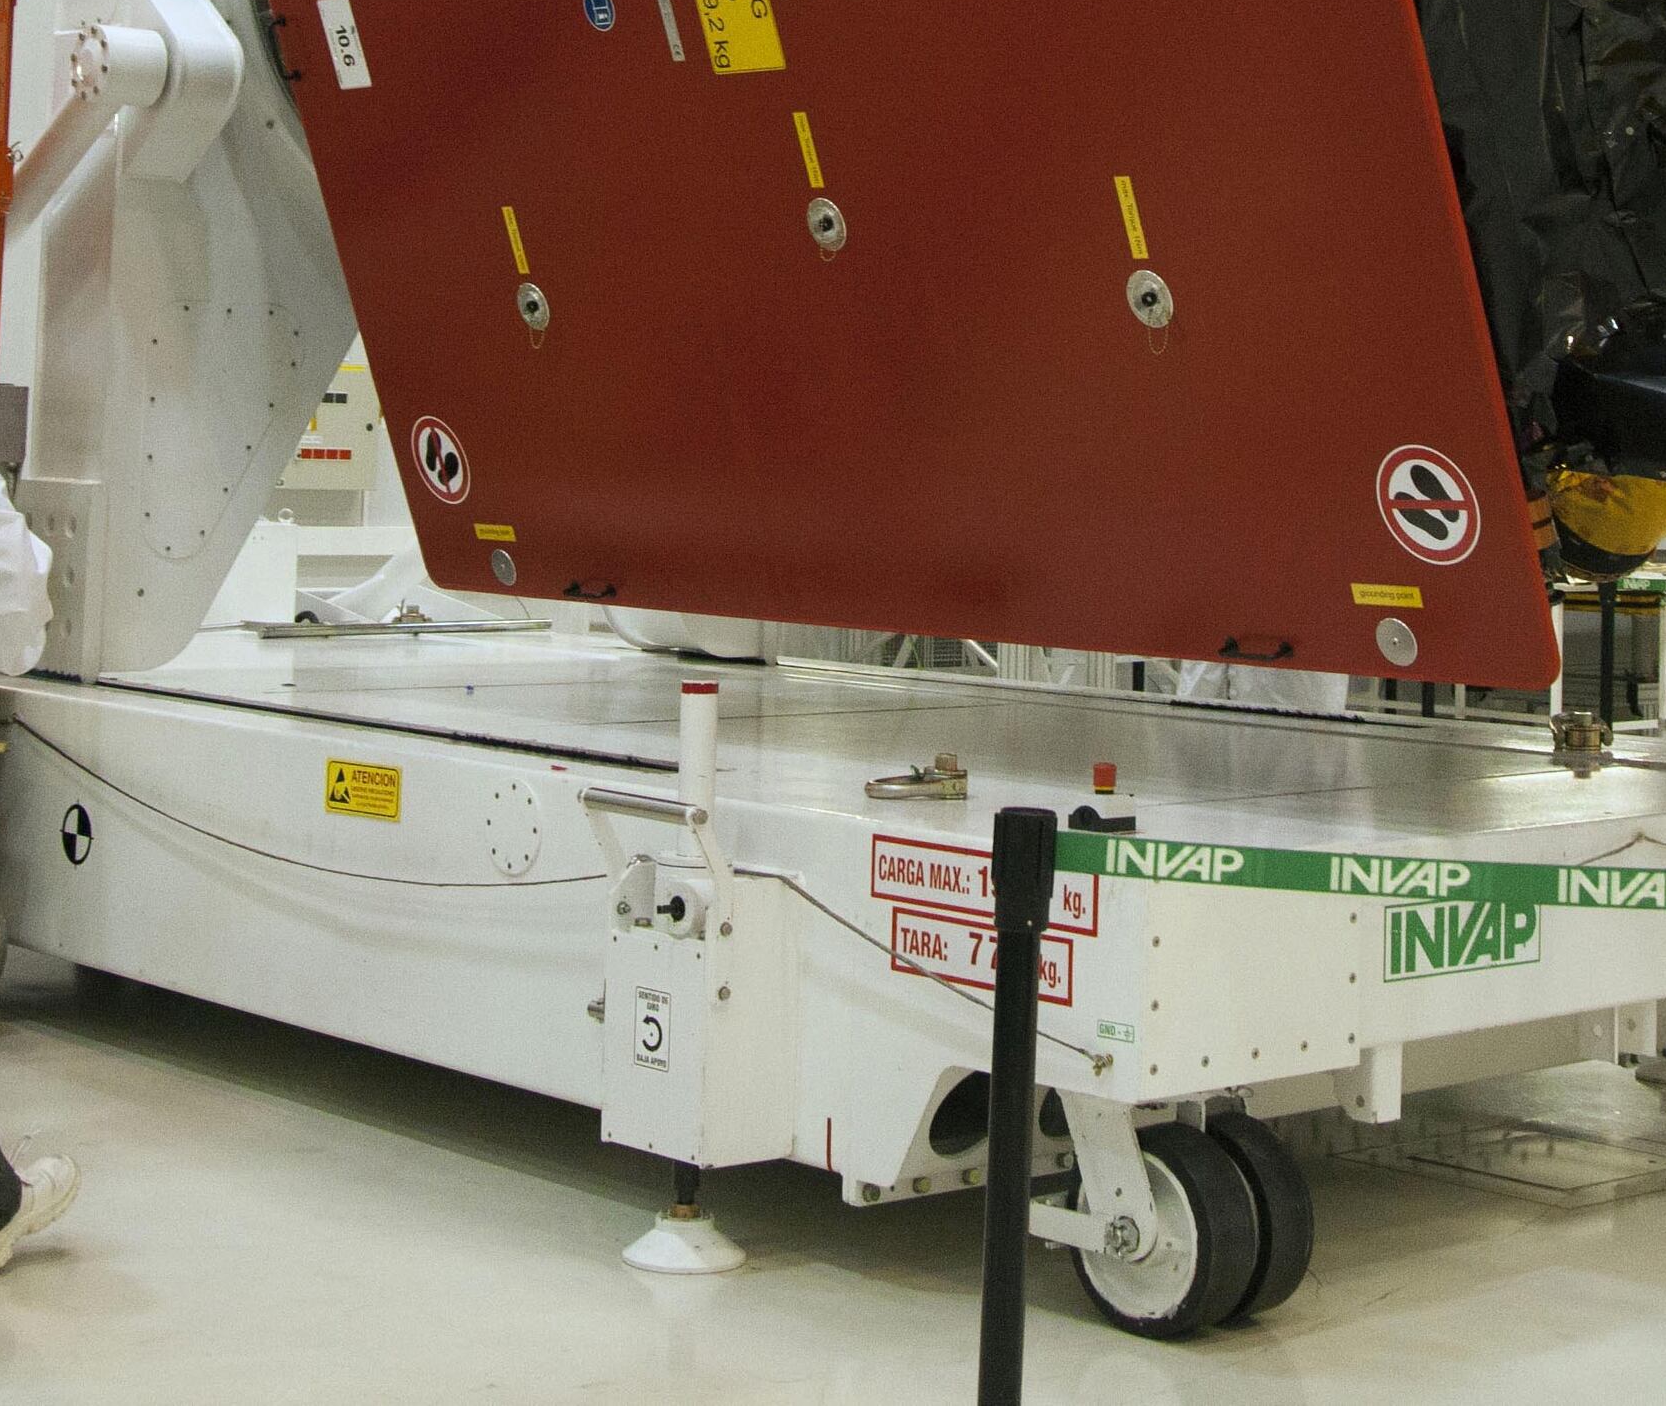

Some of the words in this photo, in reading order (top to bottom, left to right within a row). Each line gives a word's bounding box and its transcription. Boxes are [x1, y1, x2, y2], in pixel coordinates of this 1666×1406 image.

[335, 21, 355, 67] 10.6
[713, 40, 731, 70] kg
[878, 854, 925, 887] CARGA
[930, 862, 971, 895] MAX.:
[1063, 884, 1086, 919] kg.
[1106, 839, 1244, 883] INVAP
[1330, 856, 1471, 896] INVAP
[900, 927, 948, 962] TARA:
[1390, 902, 1538, 976] INVAP
